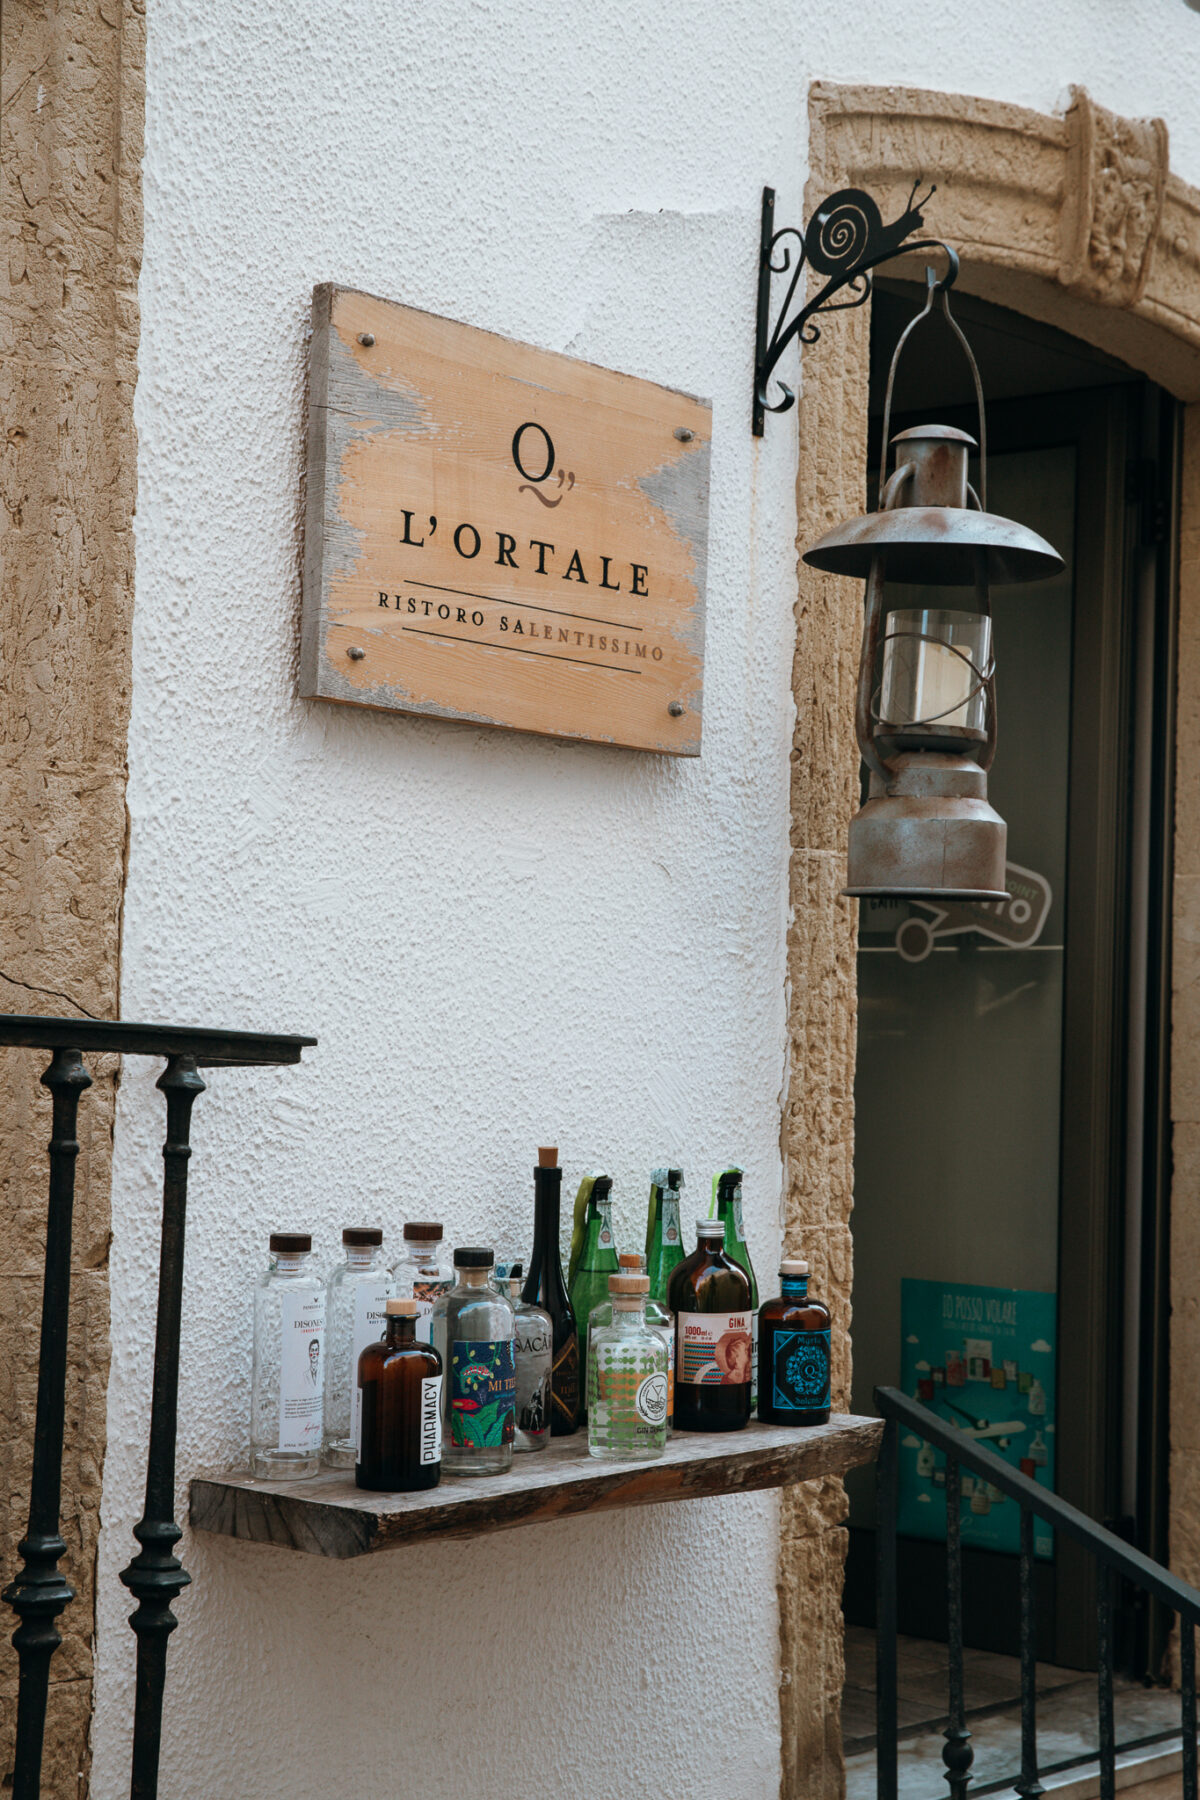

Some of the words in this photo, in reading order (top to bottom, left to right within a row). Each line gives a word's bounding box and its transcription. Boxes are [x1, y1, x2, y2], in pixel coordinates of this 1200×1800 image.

[400, 509, 649, 597] L'ORTALE
[378, 592, 484, 626] RISTORO
[500, 616, 664, 661] SALENTISSIMO
[729, 1317, 745, 1328] GINA
[423, 1382, 437, 1461] PHARMACY
